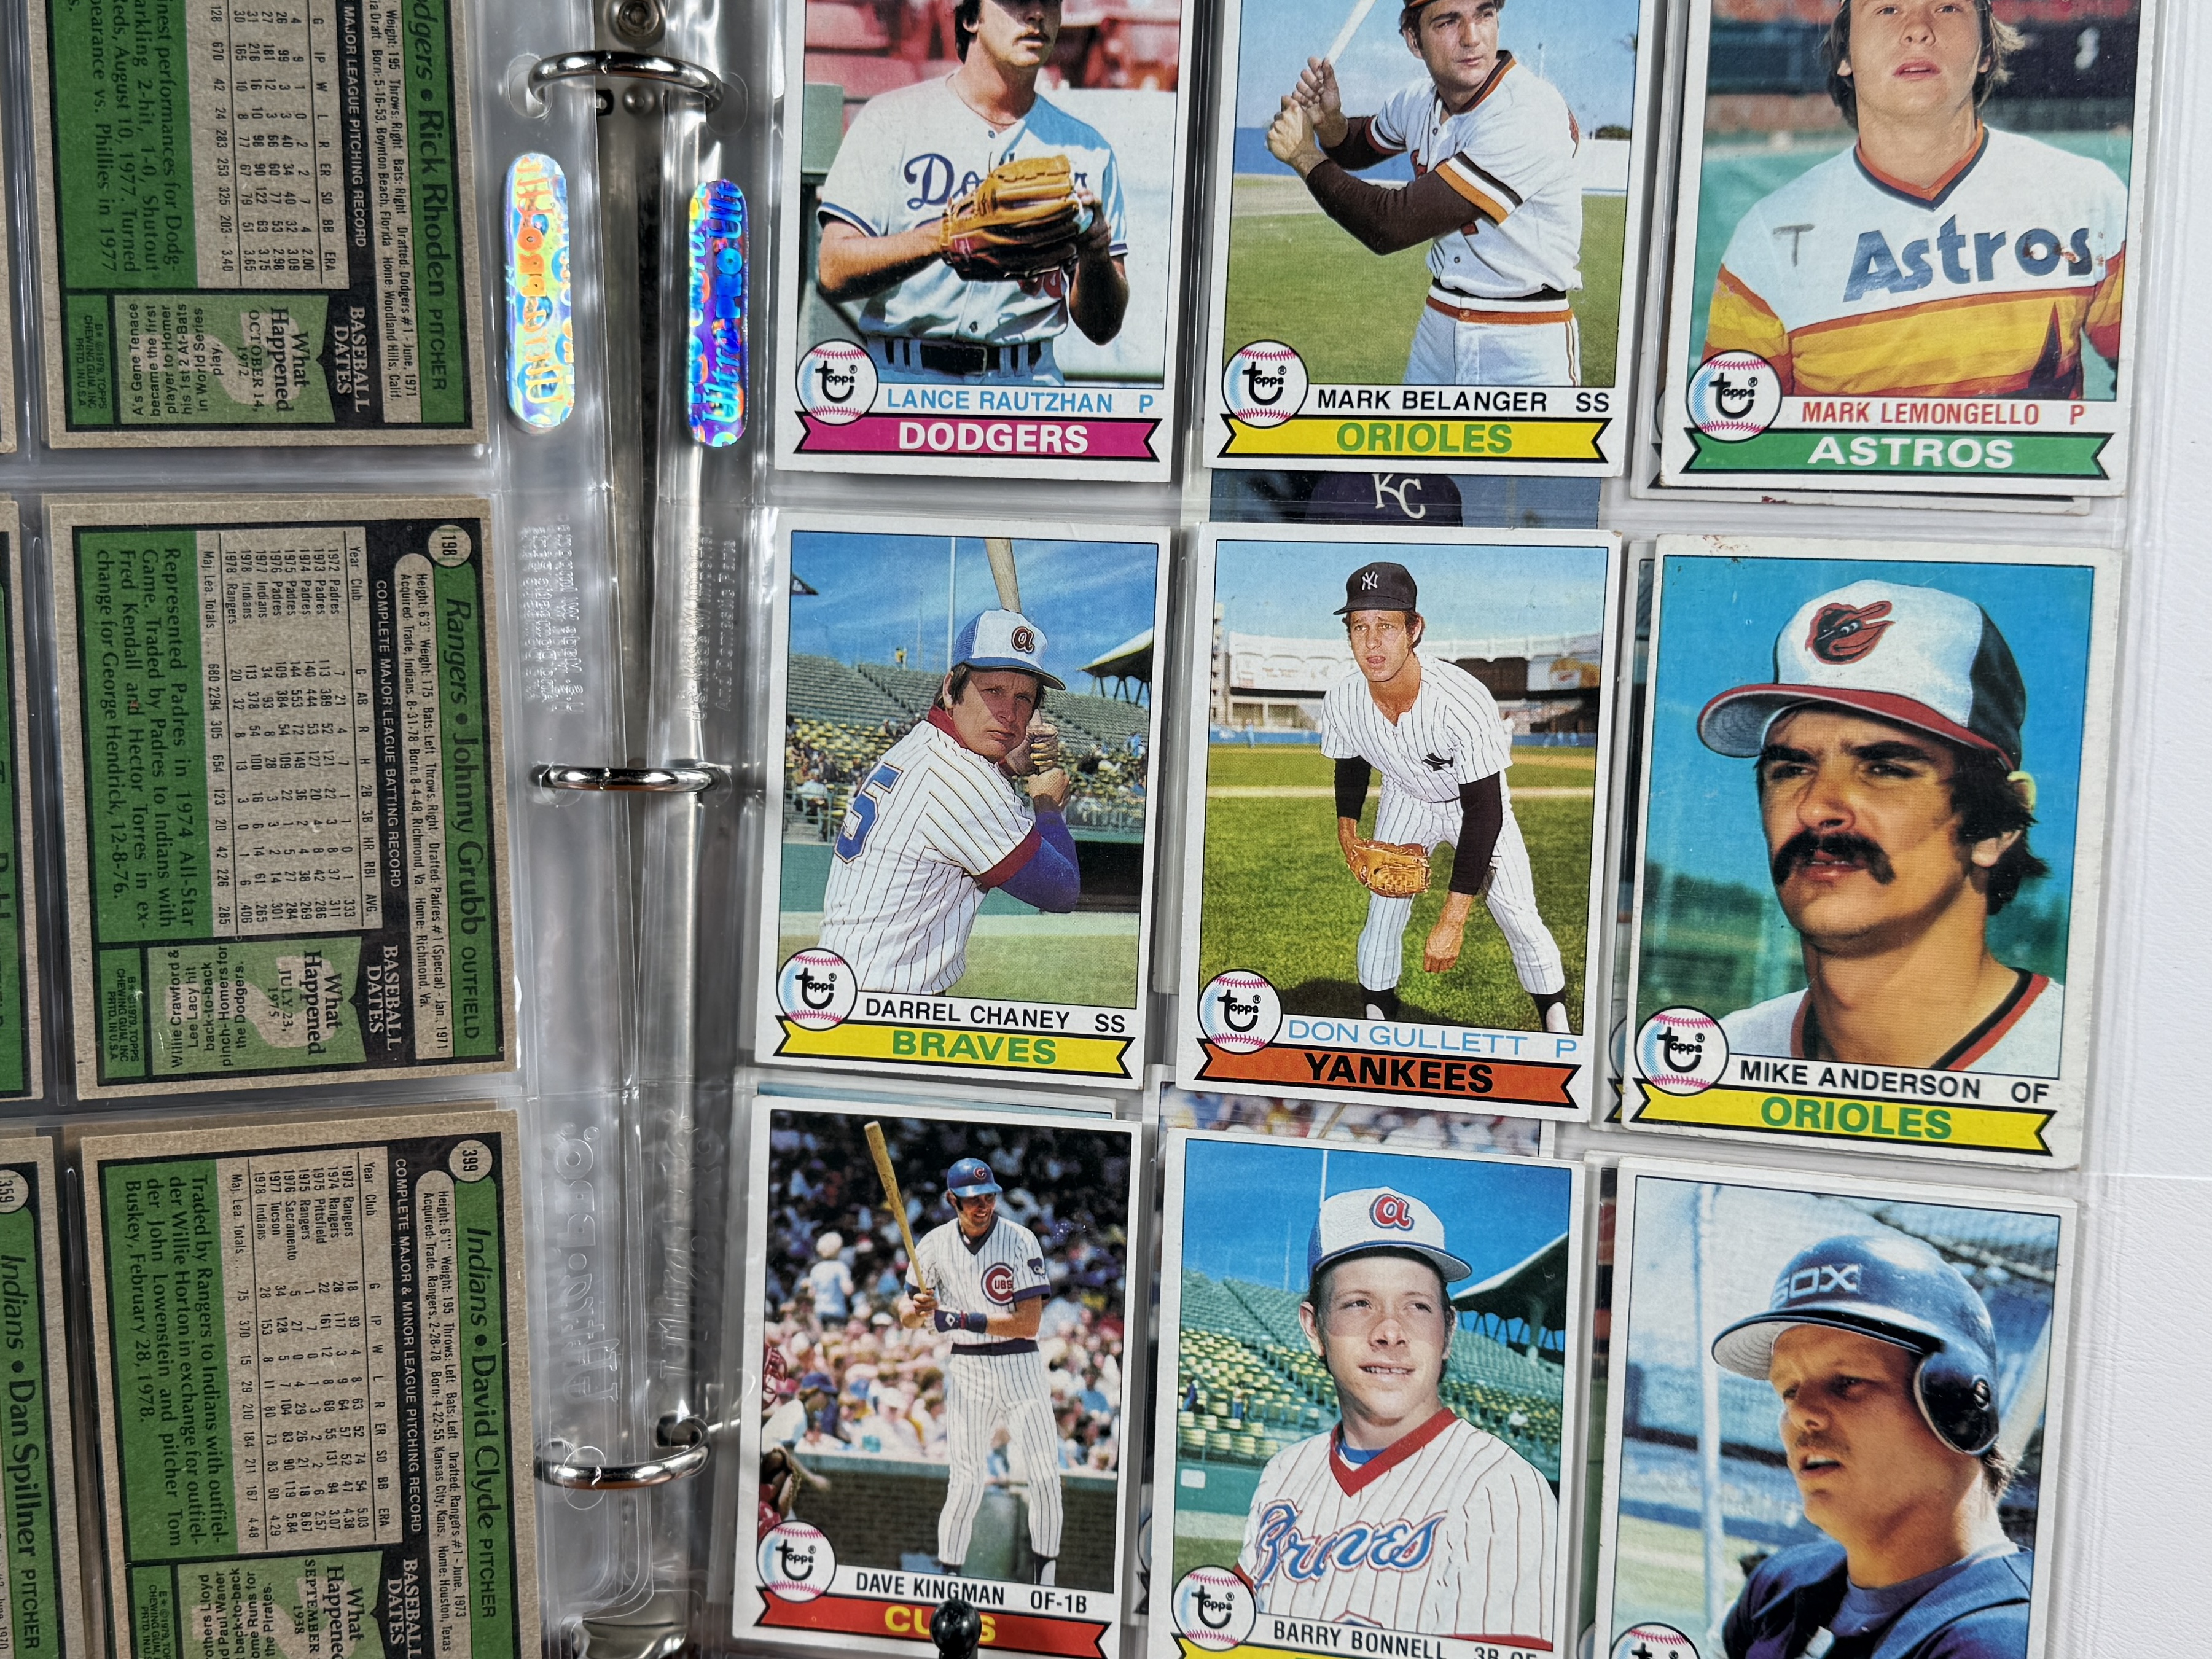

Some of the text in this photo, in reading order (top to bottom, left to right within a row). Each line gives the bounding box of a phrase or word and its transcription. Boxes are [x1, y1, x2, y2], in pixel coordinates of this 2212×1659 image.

[384, 9, 399, 49] Weight:
[388, 52, 401, 70] 195
[389, 79, 401, 119] Throws:
[343, 6, 367, 247] MAJOR LEAGUE PITCHING RECORD
[389, 122, 404, 149] Right
[418, 109, 447, 174] Rick
[393, 158, 405, 185] Bats:
[393, 187, 407, 214] Right
[397, 227, 410, 268] Drafted:
[422, 184, 453, 297] Rhoden
[1841, 214, 2095, 305] Astros
[397, 271, 412, 314] Dodgers
[236, 346, 249, 377] 1972
[246, 308, 265, 413] OCTOBER 14,
[265, 306, 295, 413] Happened
[291, 330, 311, 388] What
[334, 325, 353, 394] DATES
[350, 306, 370, 413] BASEBALL
[402, 343, 415, 370] June,
[428, 308, 447, 390] PITCHER
[405, 373, 417, 396] 1971
[888, 388, 1154, 413] LANCE RAUTZHAN P
[1318, 389, 1609, 413] MARK BELANGER SS
[1802, 401, 2085, 426] MARK LEMONGELLO P
[899, 421, 1088, 454] DODGERS
[1336, 422, 1512, 454] ORIOLES
[1807, 436, 2014, 469] ASTROS
[441, 535, 458, 556] 198
[95, 549, 130, 899] change for George Hendrick, 12-8-76.
[119, 550, 152, 929] Fred Kendall and Hector Torres in ex-
[141, 548, 177, 927] Game. Traded by Padres to Indians with
[161, 548, 198, 926] Represented Padres in 1974 All-Star
[376, 580, 401, 887] COMPLETE MAJOR LEAGUE BATTING RECORD
[443, 598, 487, 1039] Rangers Johnny Grubb OUTFIELD
[266, 986, 283, 1018] 1975
[278, 969, 294, 1032] JULY 23,
[299, 948, 327, 1056] Happened
[324, 972, 344, 1029] What
[367, 965, 385, 1033] DATES
[383, 945, 402, 1051] BASEBALL
[866, 998, 1125, 1034] DARREL CHANEY SS
[893, 1029, 1056, 1065] BRAVES
[1288, 1020, 1577, 1058] DON GULLETT P
[1302, 1051, 1495, 1095] YANKEES
[1740, 1060, 2049, 1104] MIKE ANDERSON OF
[1759, 1095, 1954, 1140] ORIOLES
[461, 1149, 479, 1172] 399
[436, 1190, 450, 1226] Height:
[439, 1255, 453, 1293] Weight:
[442, 1296, 454, 1314] 195
[395, 1158, 421, 1532] COMPLETE MAJOR & MINOR LEAGUE PITCHING RECORD
[443, 1322, 455, 1361] Throws:
[445, 1364, 456, 1384] Left
[466, 1227, 502, 1618] Indians David Clyde PITCHER
[1, 1254, 42, 1649] Indians Dan Spillner PITCHER
[304, 1559, 320, 1654] SEPTEMBER
[346, 1586, 365, 1641] What
[387, 1577, 405, 1645] DATES
[402, 1558, 423, 1659] BASEBALL
[856, 1572, 1087, 1614] DAVE KINGMAN OF-1B
[292, 1605, 305, 1634] 1938
[883, 1604, 997, 1643] CUS
[1274, 1620, 1342, 1647] BARRY
[1350, 1636, 1448, 1659] BONNELL
